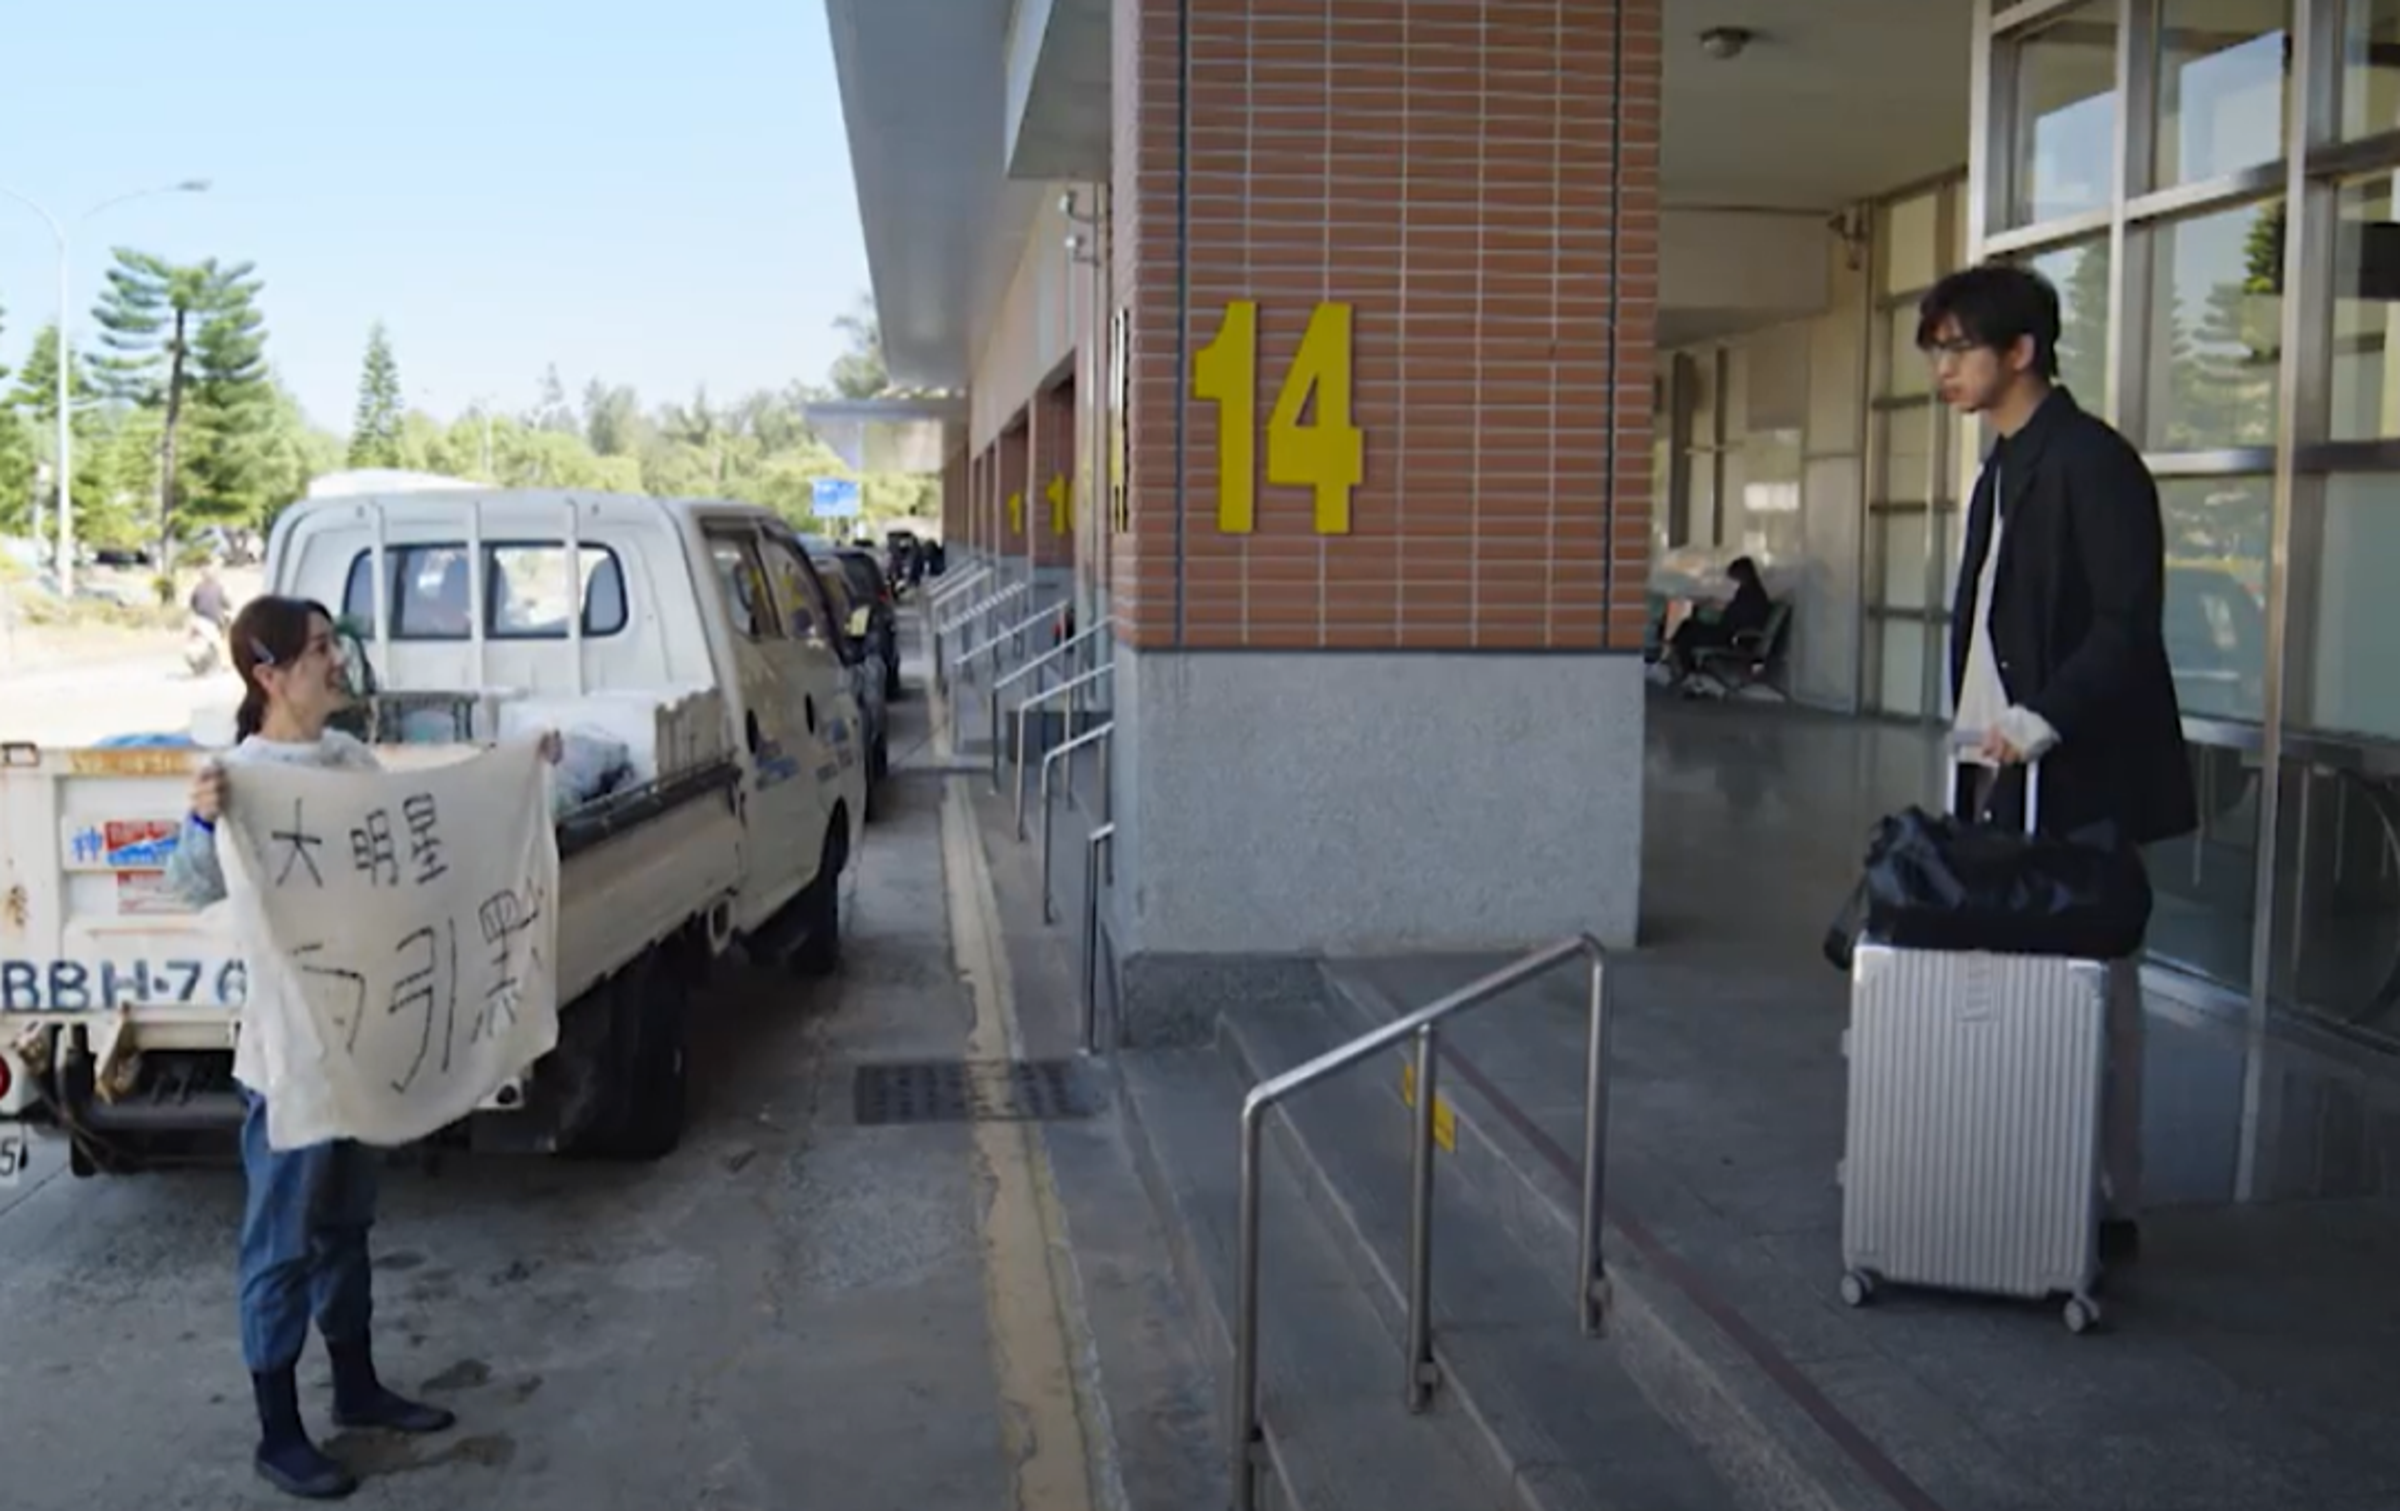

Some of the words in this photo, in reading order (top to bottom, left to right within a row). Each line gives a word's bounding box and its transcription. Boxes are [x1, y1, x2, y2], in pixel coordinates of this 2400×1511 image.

[1193, 300, 1364, 535] 14
[272, 793, 449, 888] 大明星
